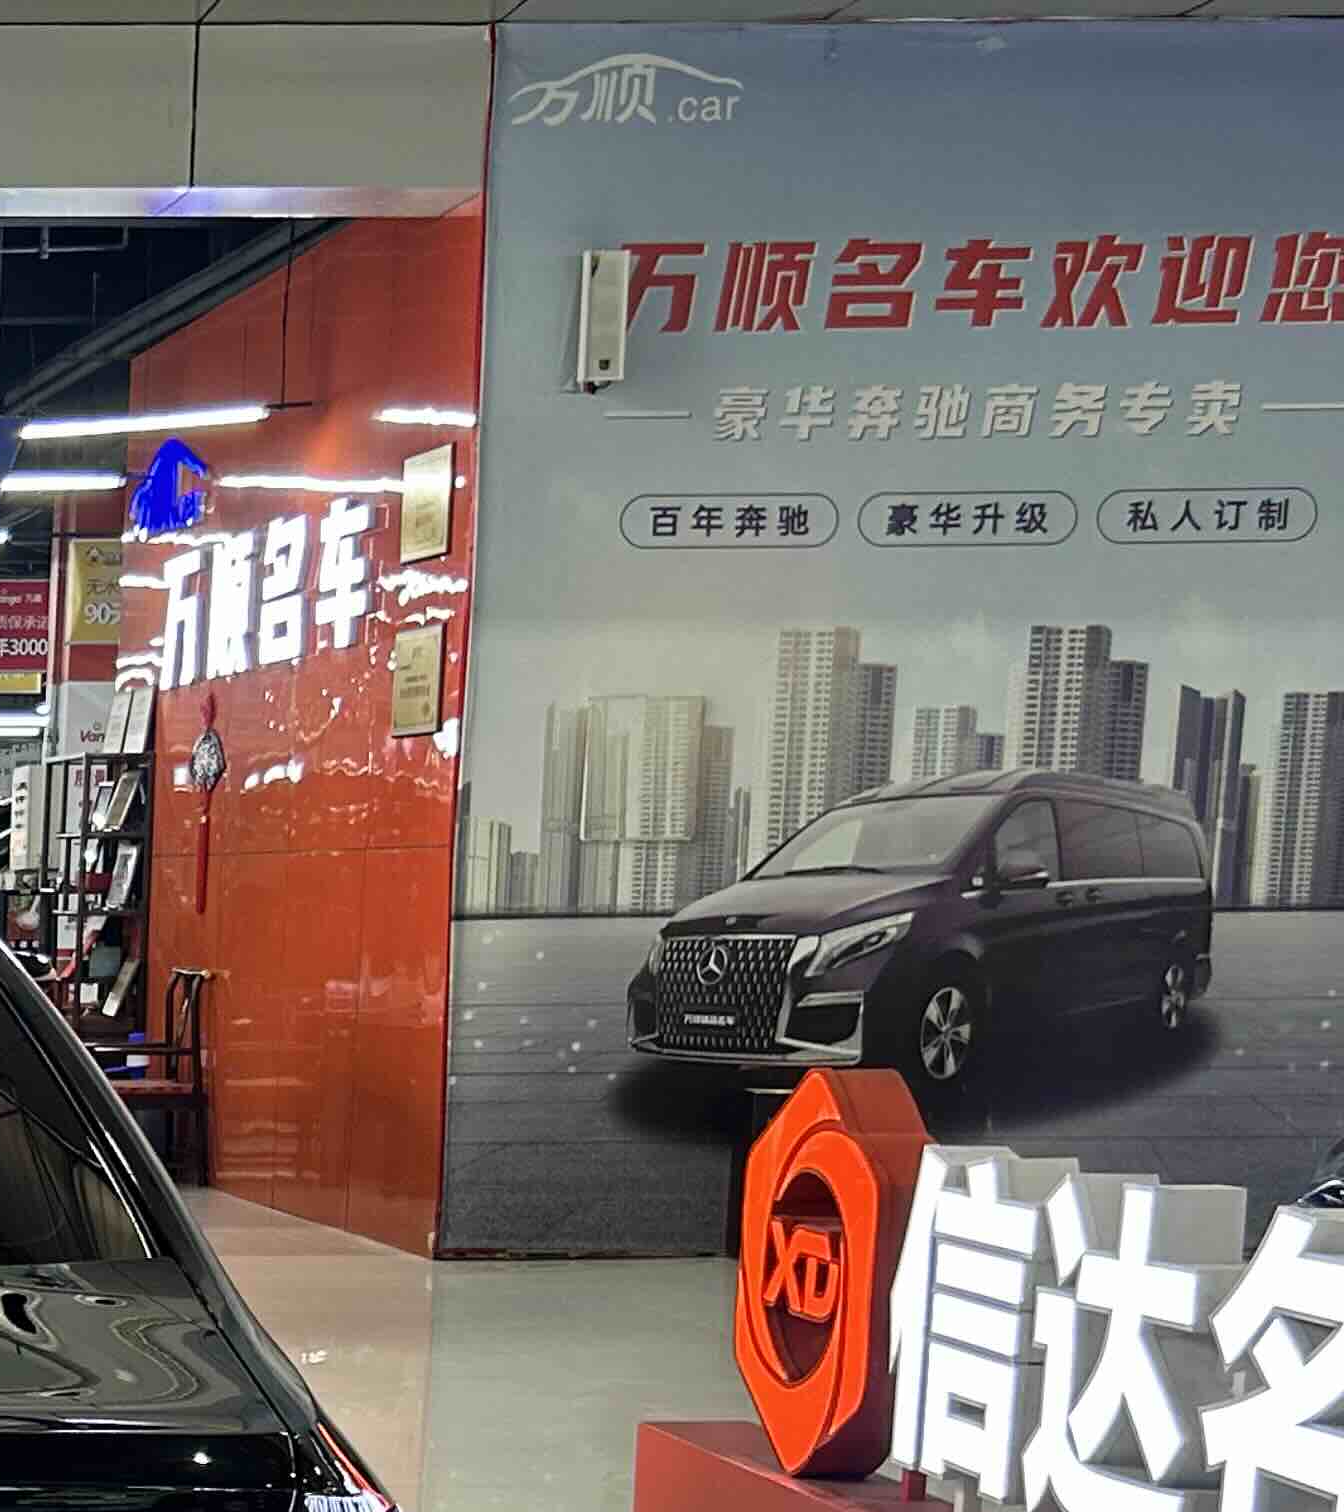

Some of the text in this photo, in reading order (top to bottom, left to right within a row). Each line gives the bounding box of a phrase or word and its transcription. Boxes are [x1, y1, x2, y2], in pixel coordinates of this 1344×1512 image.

[615, 233, 1344, 334] 万顺名车欢迎您
[711, 383, 1244, 441] 豪华奔驰商务专卖
[649, 502, 813, 540] 百年奔驰
[885, 500, 1051, 538] 豪华升级
[1126, 497, 1294, 534] 私人订制
[158, 497, 374, 692] 万顺名车
